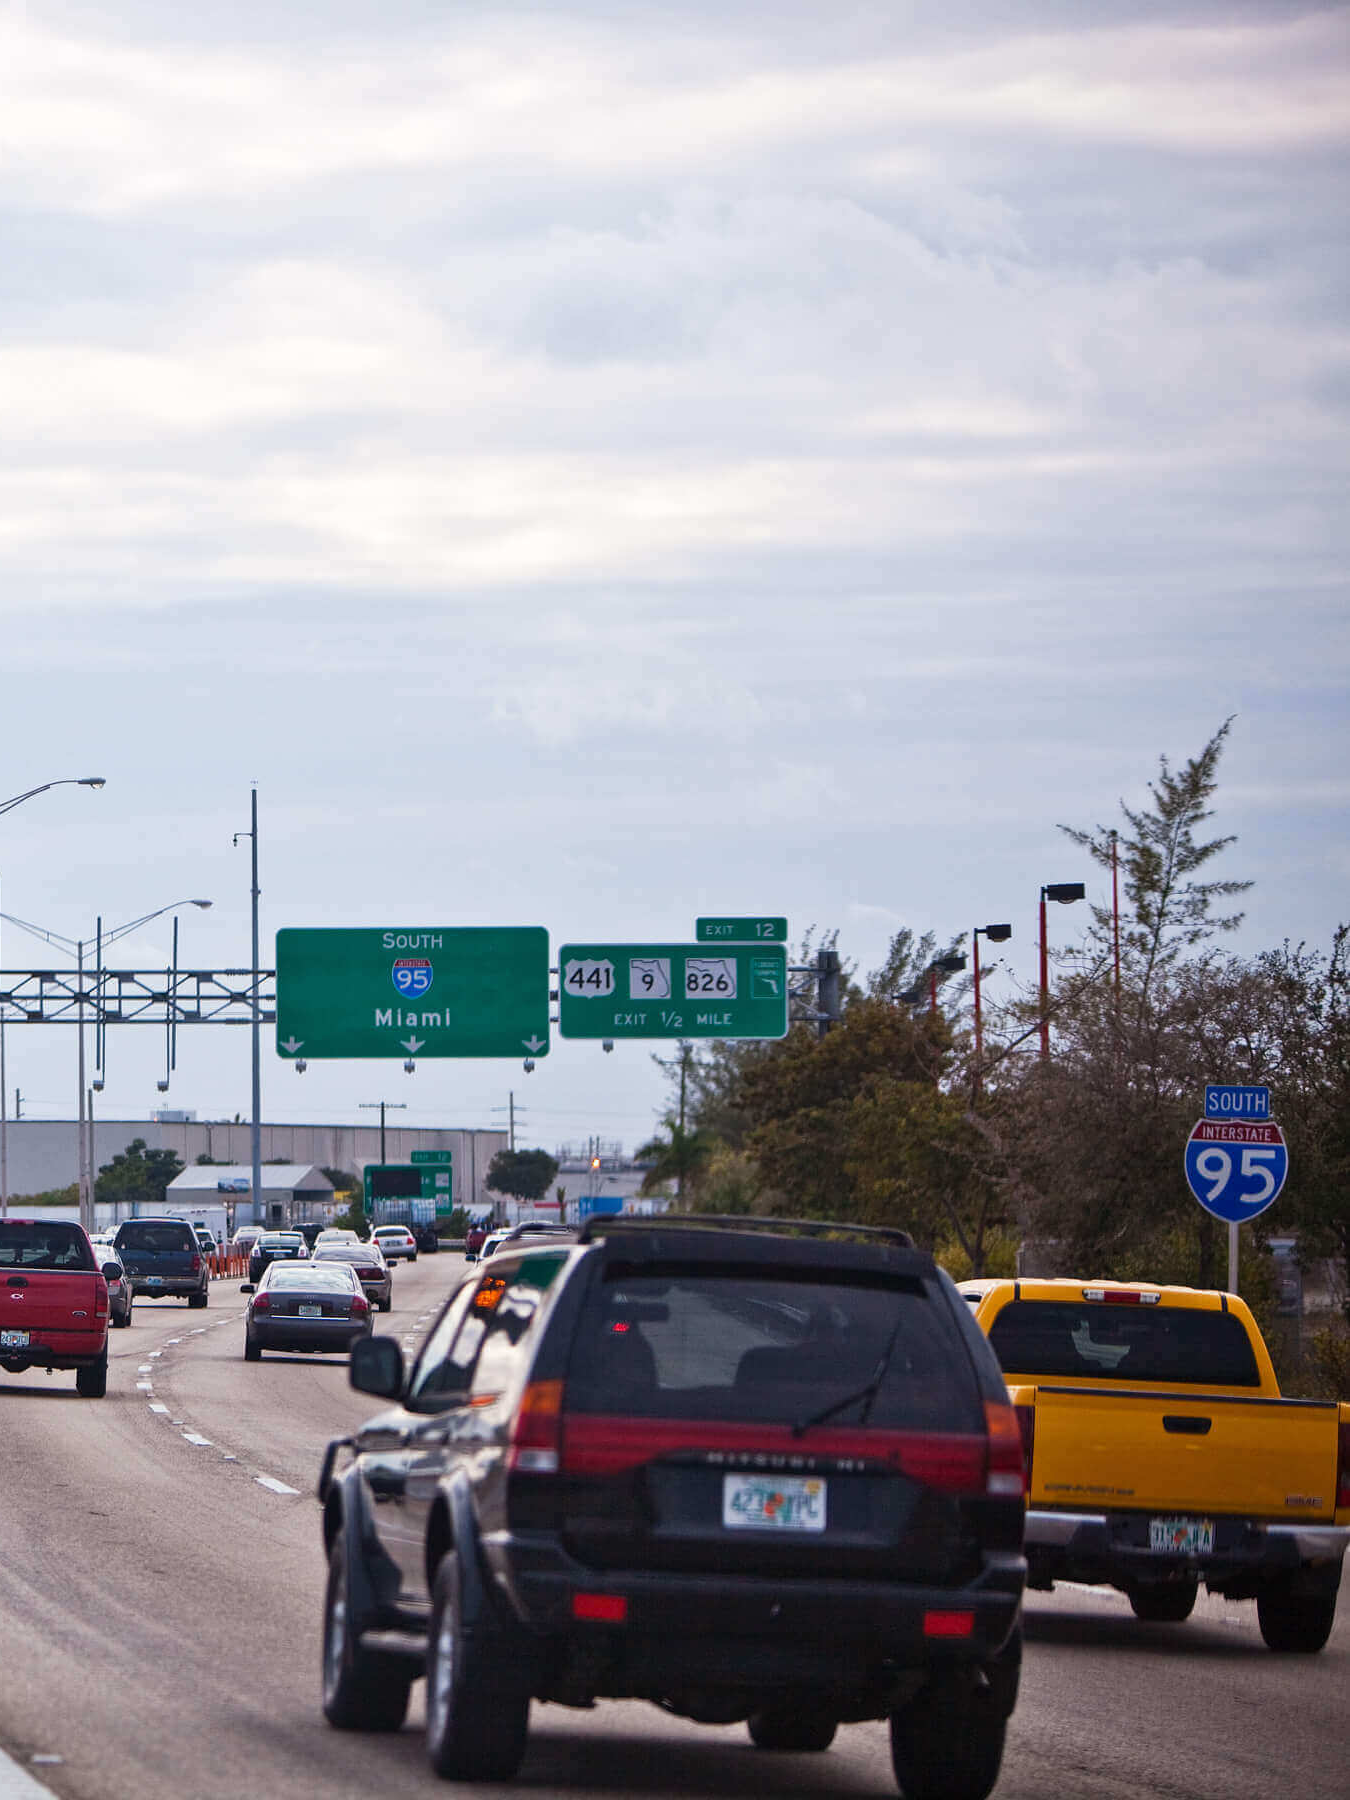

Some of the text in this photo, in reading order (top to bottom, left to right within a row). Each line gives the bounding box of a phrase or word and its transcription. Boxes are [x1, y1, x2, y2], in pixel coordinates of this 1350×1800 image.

[705, 923, 775, 937] EXIT 12
[382, 932, 443, 949] SOUTH
[397, 970, 428, 989] 95
[569, 967, 611, 989] 441
[641, 973, 654, 991] 9
[686, 973, 729, 991] 826
[375, 1008, 450, 1027] Miami
[614, 1013, 647, 1025] EXIT
[696, 1013, 733, 1025] MILE
[1208, 1092, 1266, 1112] SOUTH
[1201, 1124, 1272, 1142] INTERSTATE
[1195, 1147, 1276, 1203] 95
